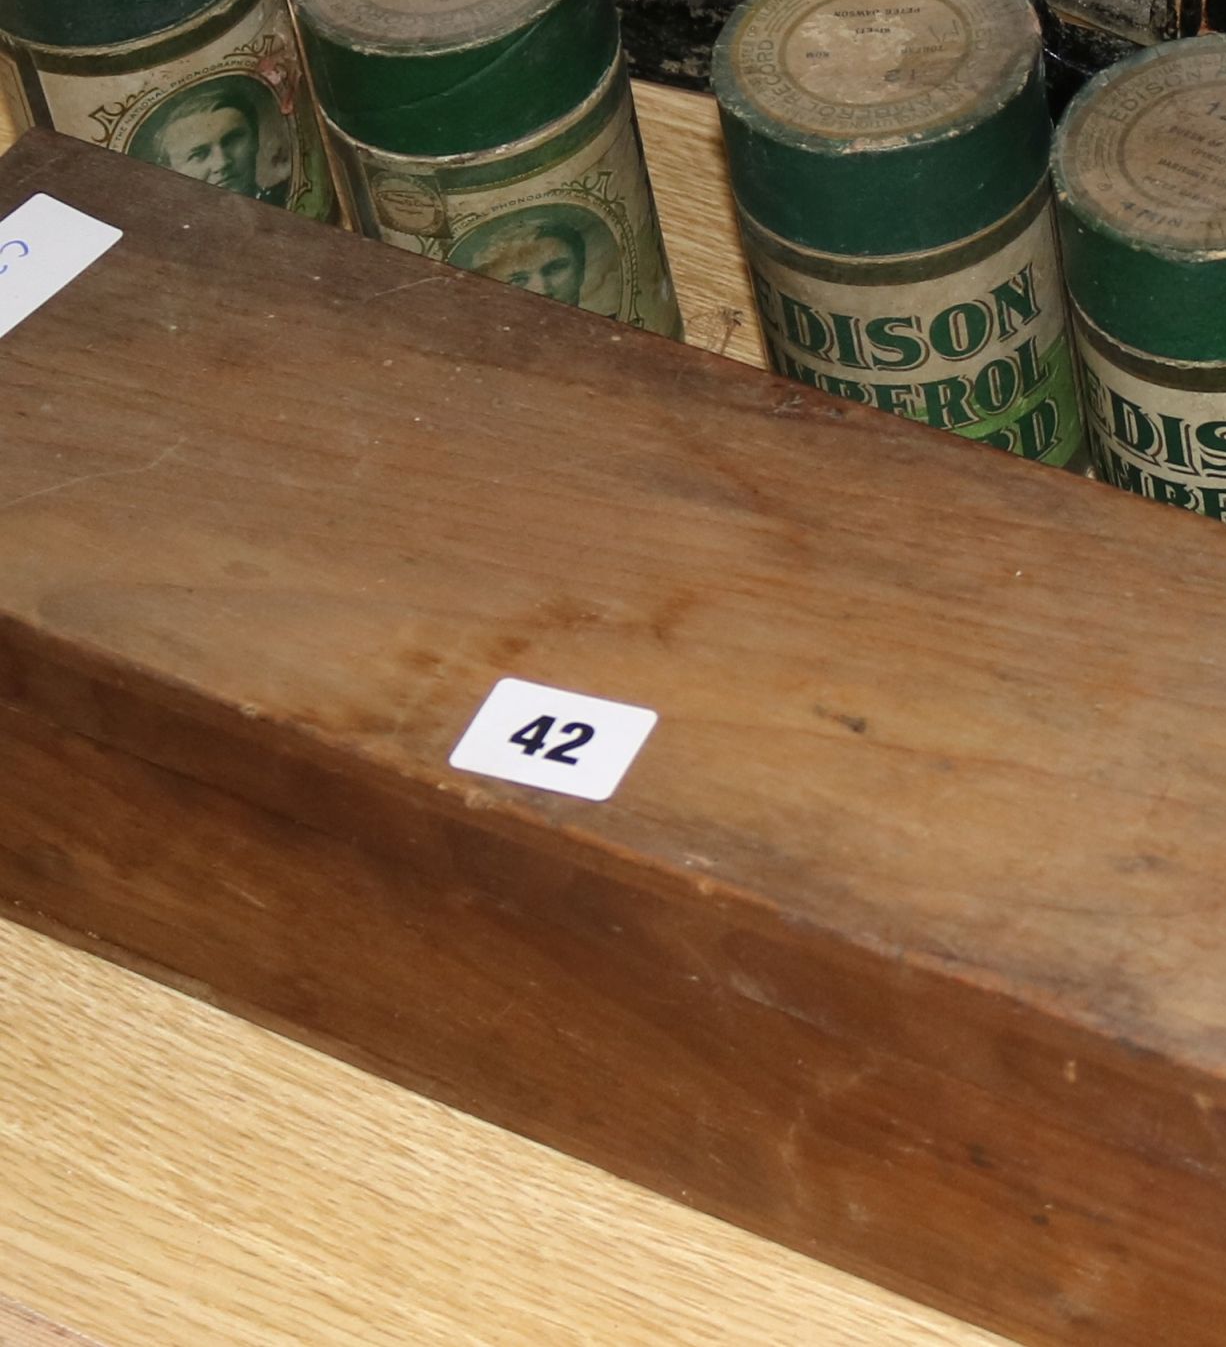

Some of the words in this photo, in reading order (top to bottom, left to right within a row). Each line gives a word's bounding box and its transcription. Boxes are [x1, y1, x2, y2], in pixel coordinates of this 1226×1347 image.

[126, 89, 166, 126] NATIONAL
[170, 60, 244, 89] PHONOGRAPH
[1109, 67, 1202, 123] EDISON
[756, 263, 1041, 372] EDISON
[508, 714, 596, 766] 42
